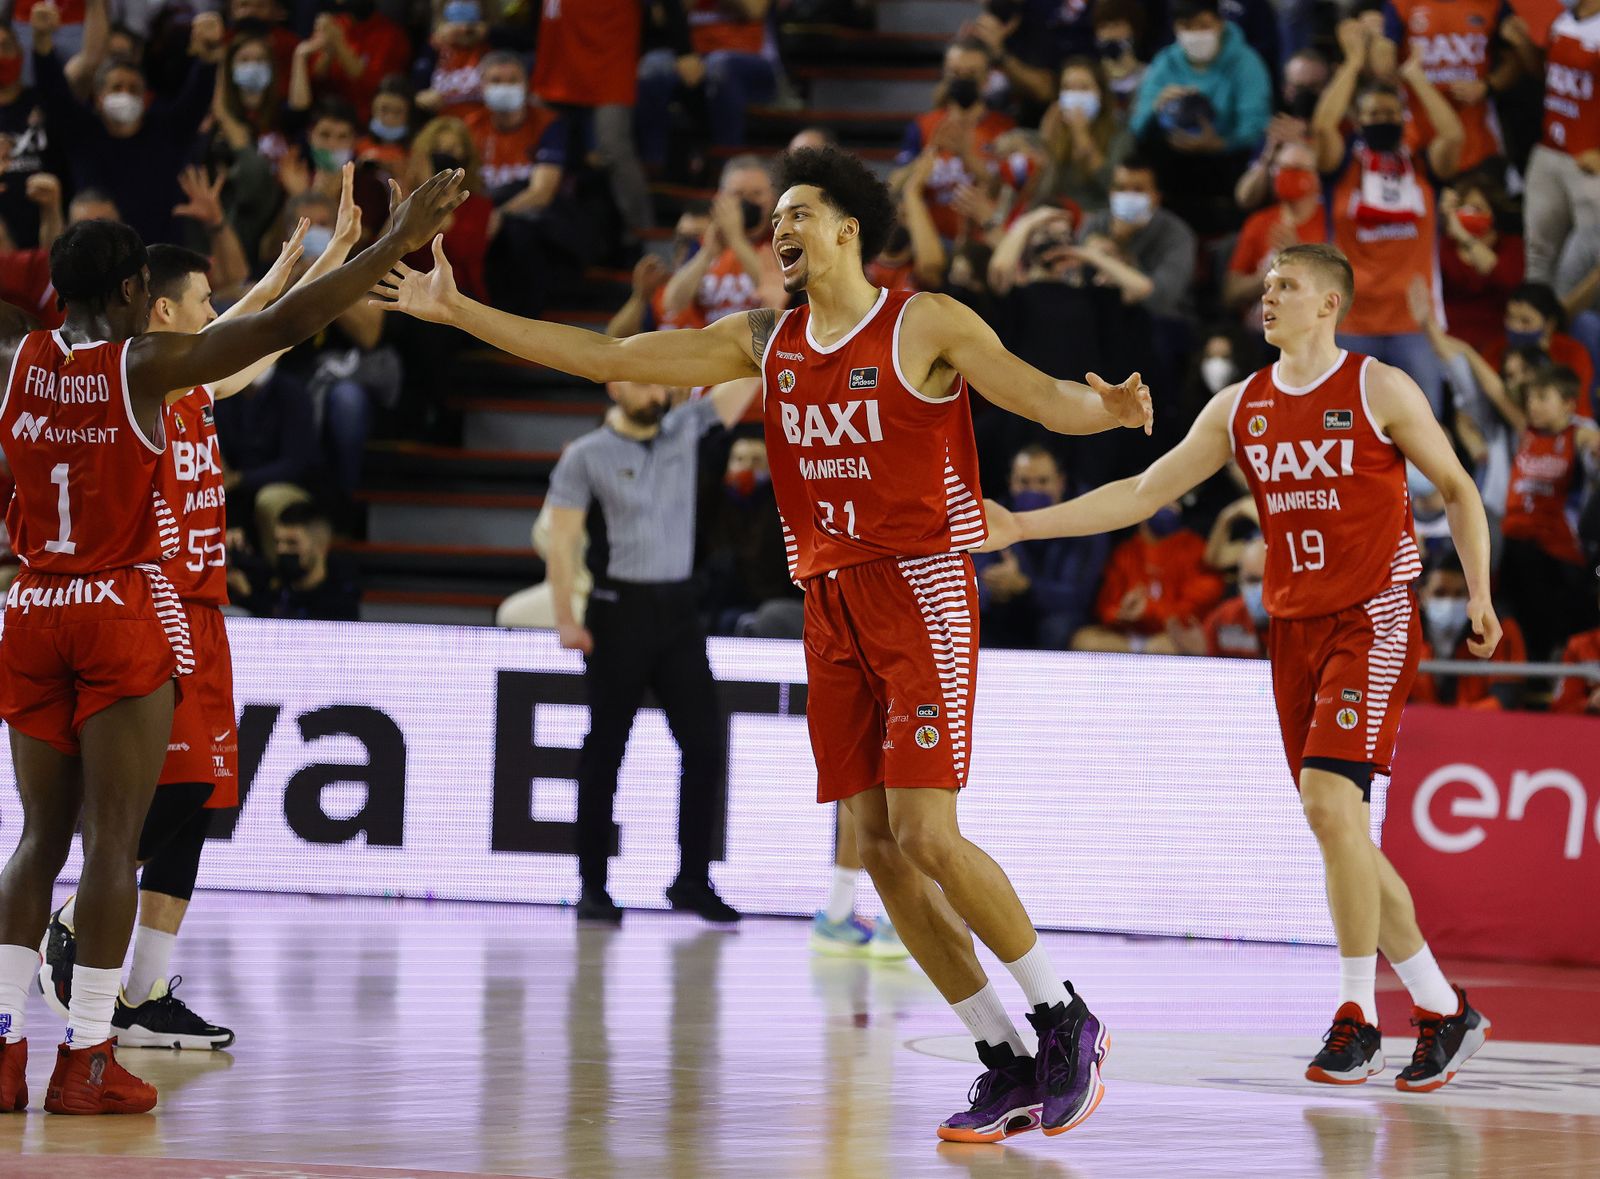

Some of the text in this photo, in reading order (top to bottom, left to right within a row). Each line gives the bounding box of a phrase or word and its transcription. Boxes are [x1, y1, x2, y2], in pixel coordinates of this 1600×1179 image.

[24, 365, 110, 404] FRACISCO
[44, 426, 119, 444] AVINENT
[779, 399, 884, 447] BAXI
[171, 434, 222, 482] BAX
[799, 456, 872, 480] MANRESA
[1244, 439, 1355, 483] BAXI
[45, 463, 76, 555] 1
[183, 486, 225, 514] MAESA
[817, 500, 860, 540] 21
[1265, 488, 1342, 516] MANRESA
[186, 526, 226, 573] 55
[1285, 529, 1326, 574] 19
[1412, 762, 1600, 860] en
